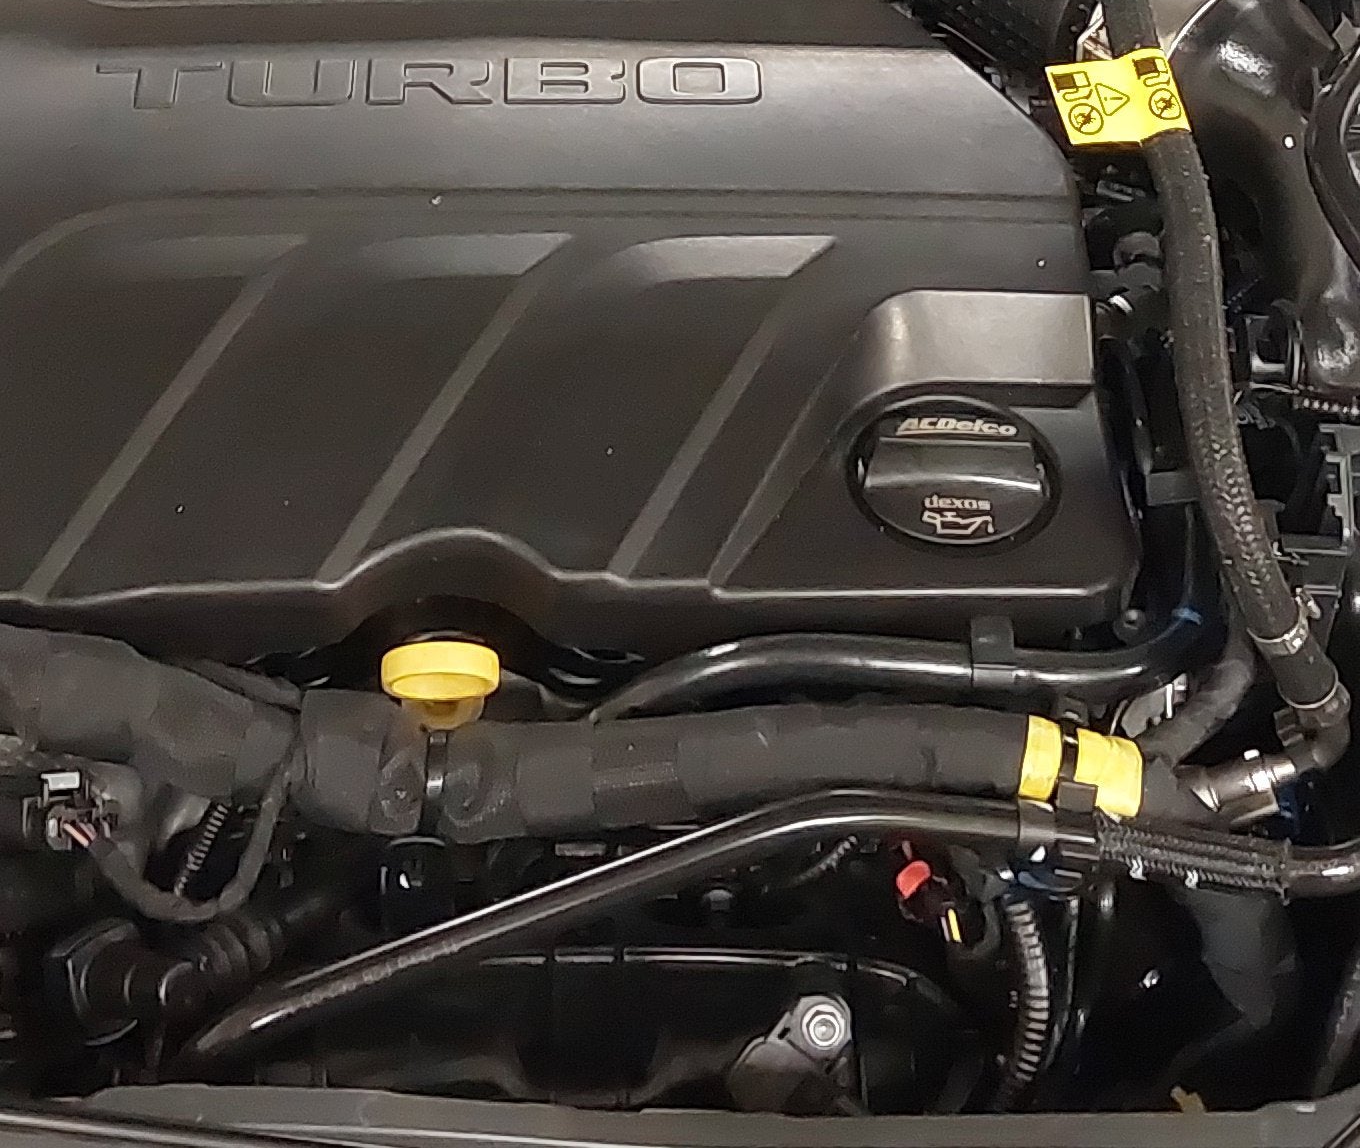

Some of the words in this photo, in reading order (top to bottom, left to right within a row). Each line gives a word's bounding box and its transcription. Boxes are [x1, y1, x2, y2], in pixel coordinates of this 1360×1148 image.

[95, 55, 763, 109] TURBO
[896, 417, 1018, 437] ACDelco
[923, 494, 992, 511] dexos
